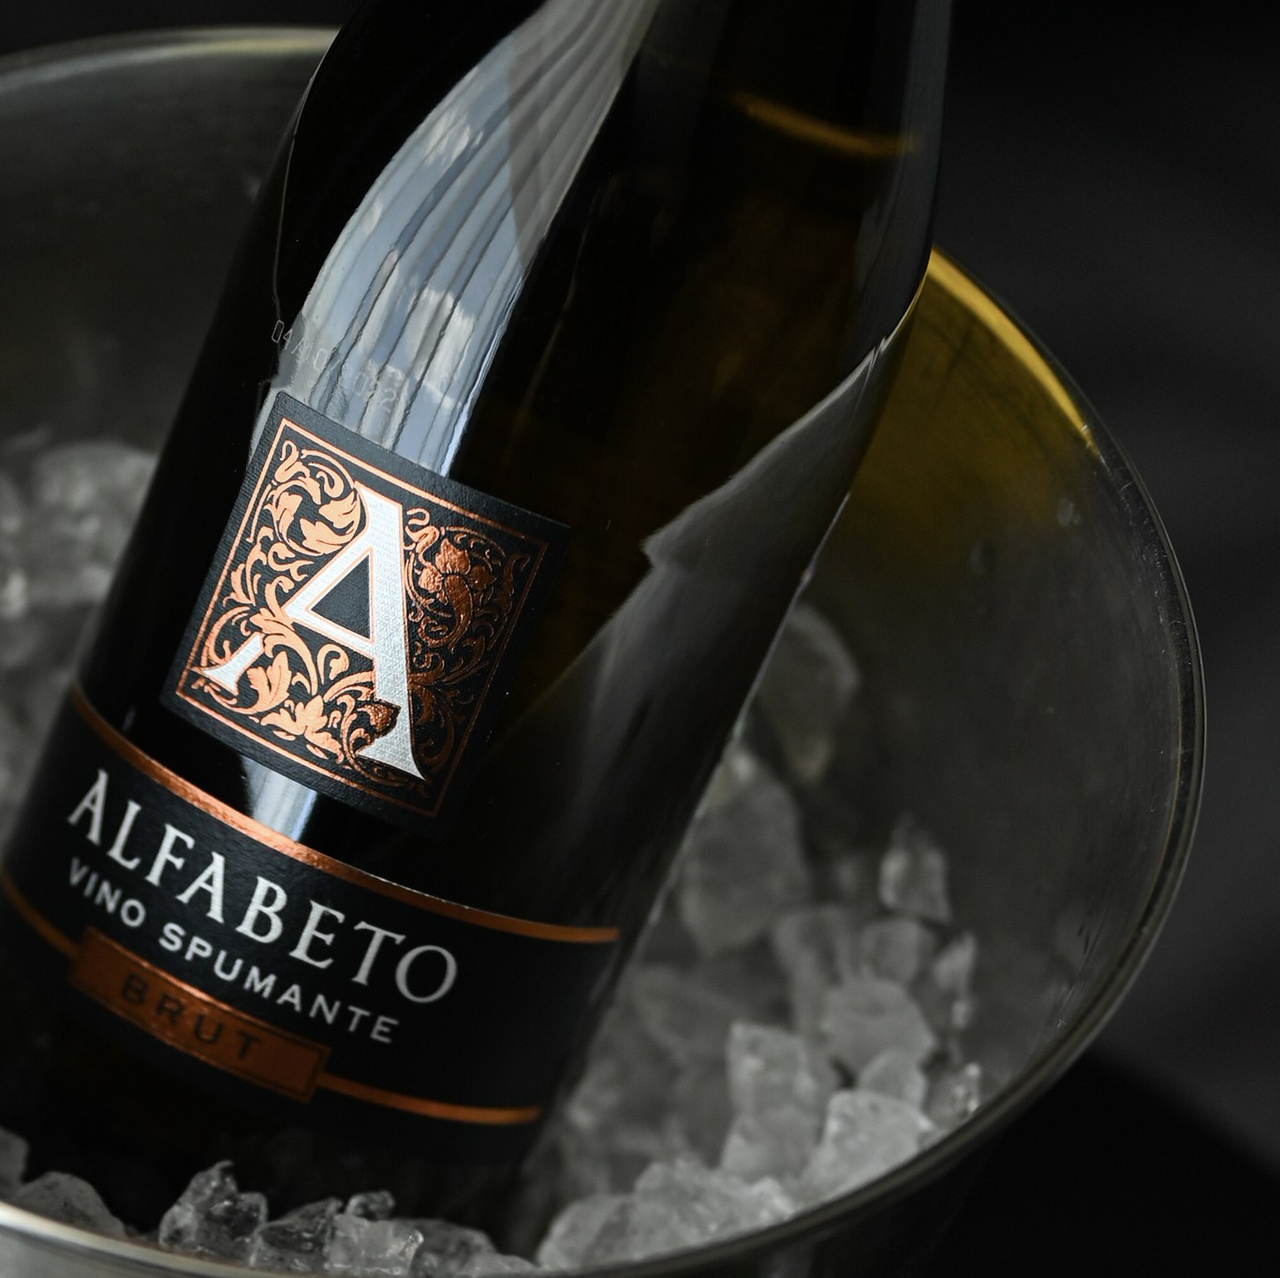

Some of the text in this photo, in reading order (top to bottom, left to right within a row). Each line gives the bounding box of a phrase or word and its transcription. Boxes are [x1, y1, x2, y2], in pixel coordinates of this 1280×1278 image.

[192, 481, 427, 778] A
[68, 770, 458, 1003] ALFABETO
[69, 858, 400, 1044] VINO SPUMANTE
[120, 974, 263, 1060] BRUT
